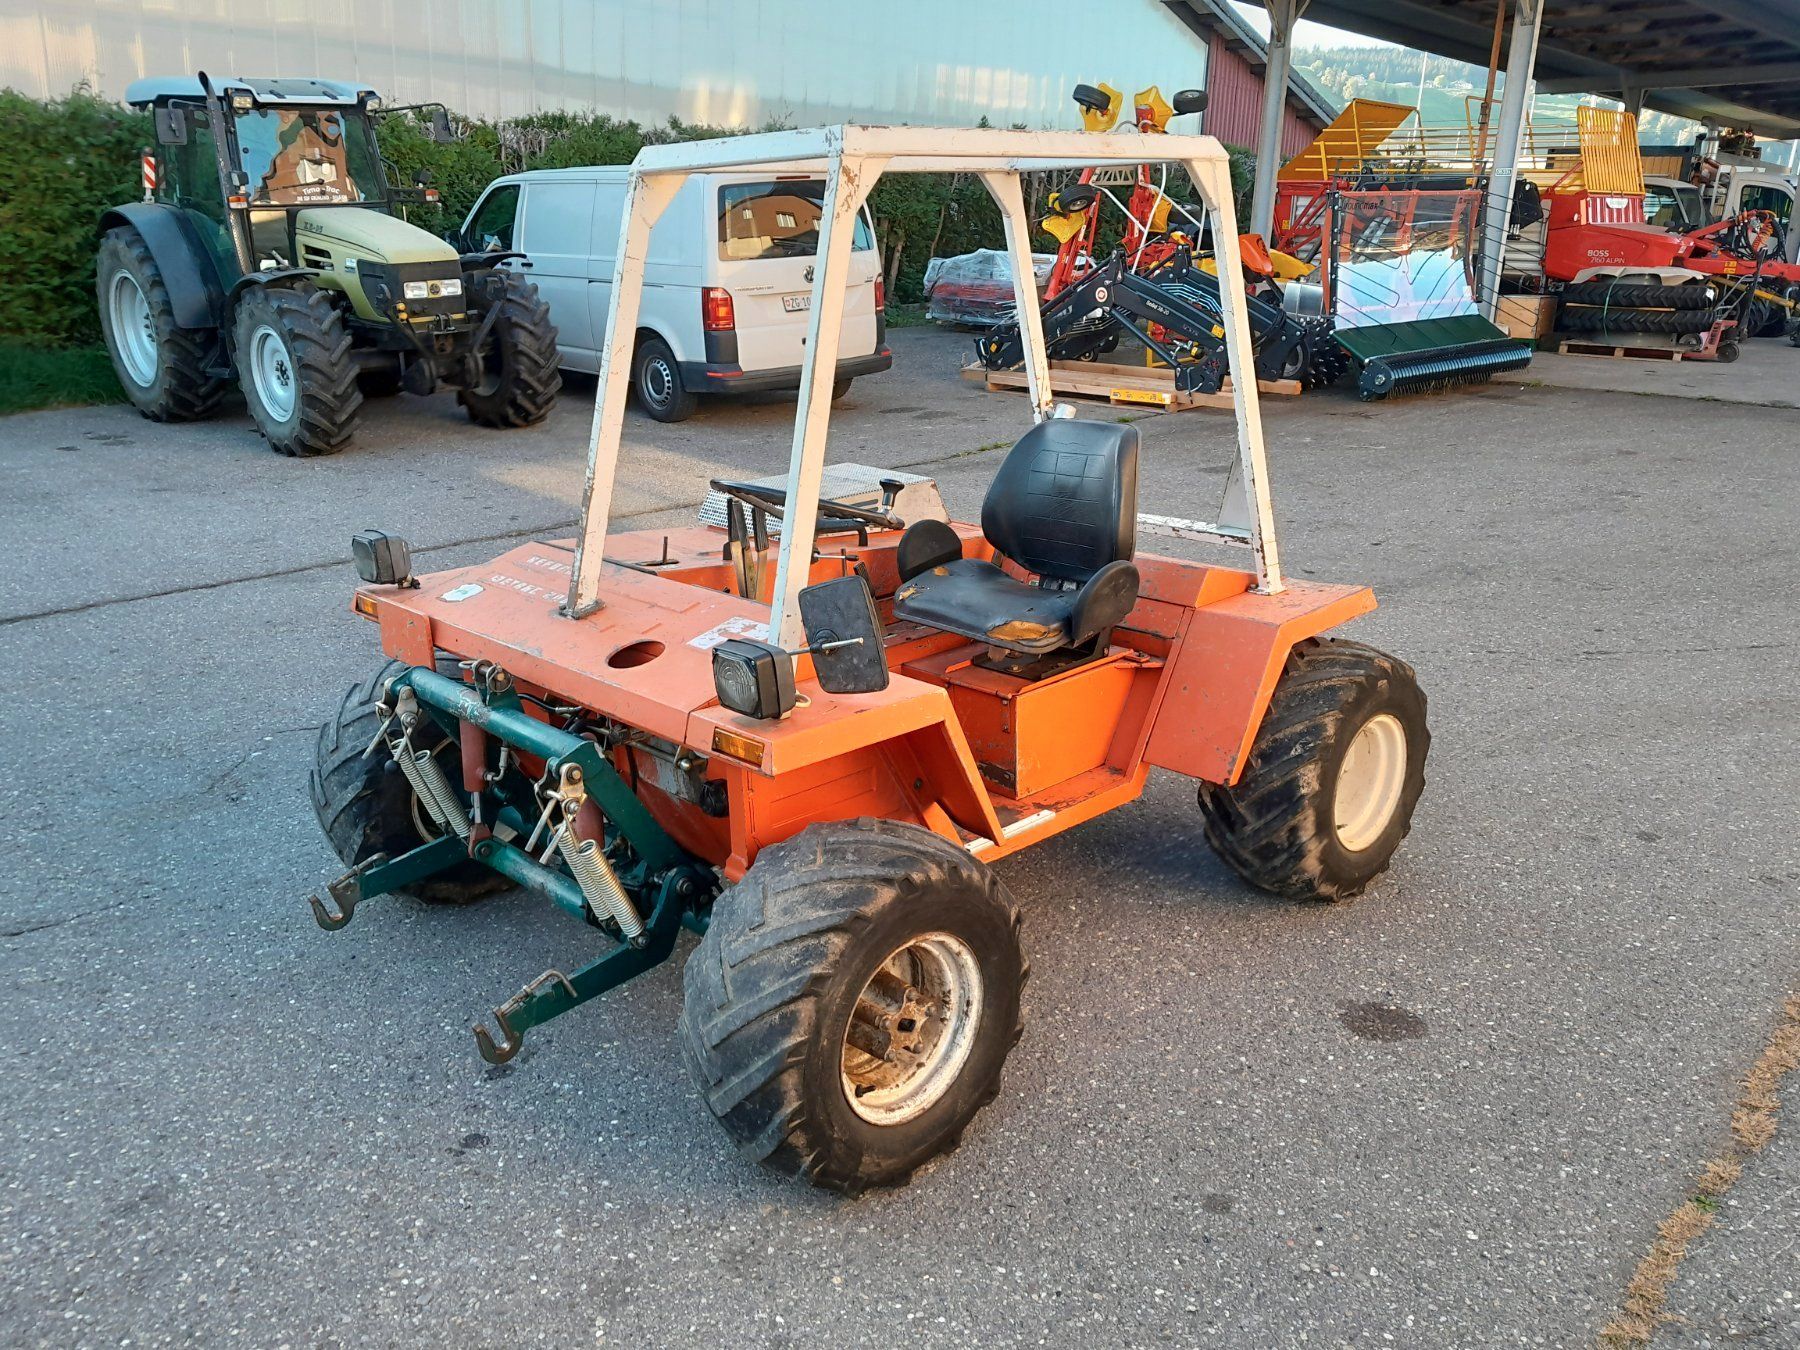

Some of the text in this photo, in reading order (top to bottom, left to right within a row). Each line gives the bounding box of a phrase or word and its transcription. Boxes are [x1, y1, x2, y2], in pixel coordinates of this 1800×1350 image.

[1587, 249, 1610, 257] BOSS
[790, 297, 800, 308] ZG
[1145, 300, 1159, 310] Solid
